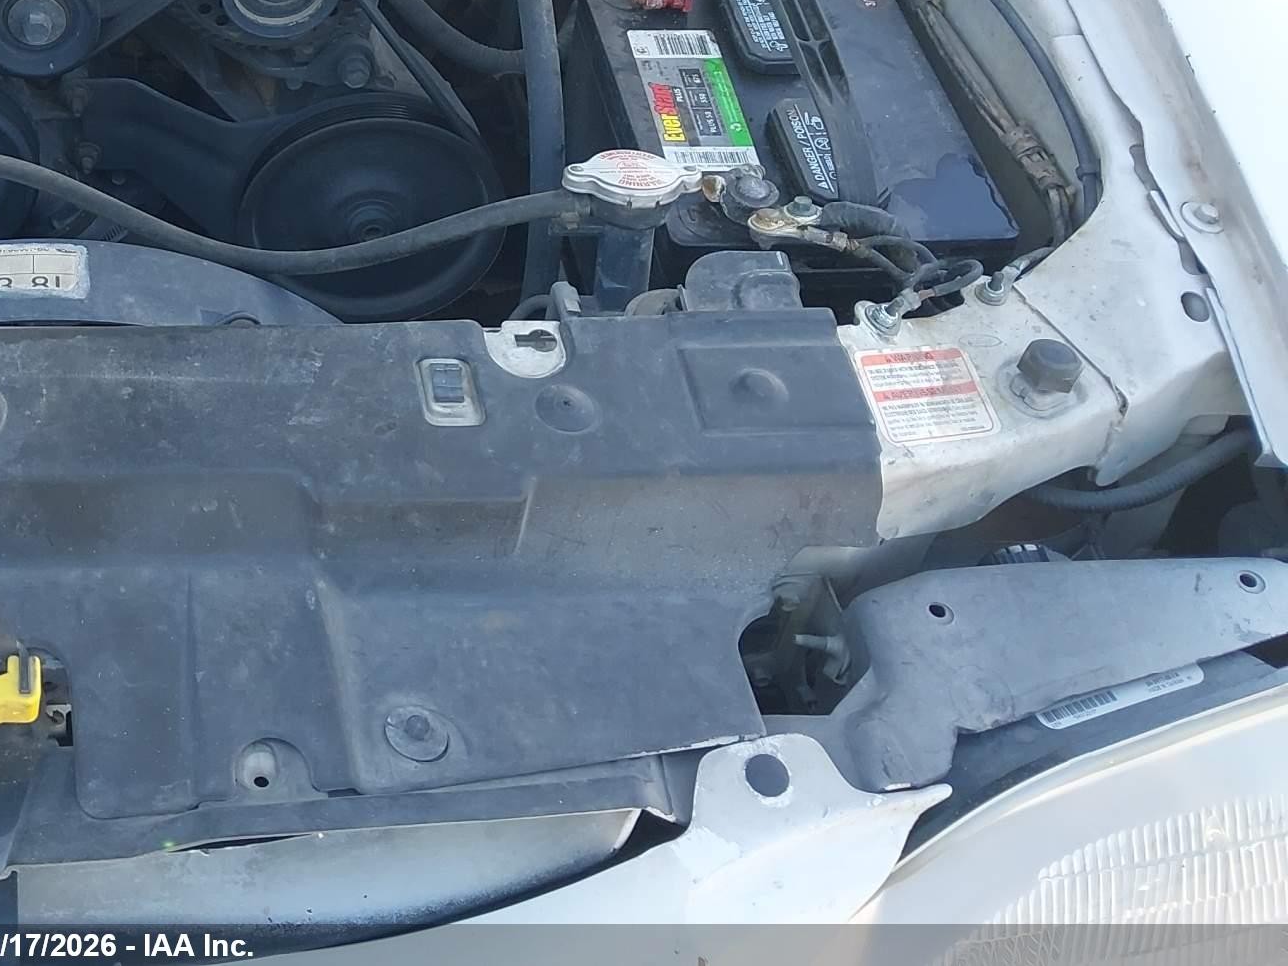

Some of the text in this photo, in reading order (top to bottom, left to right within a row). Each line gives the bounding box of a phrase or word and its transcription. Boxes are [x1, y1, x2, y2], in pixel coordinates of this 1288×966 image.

[673, 88, 684, 102] PLUS
[786, 109, 808, 139] POISON
[803, 147, 826, 184] DANGER
